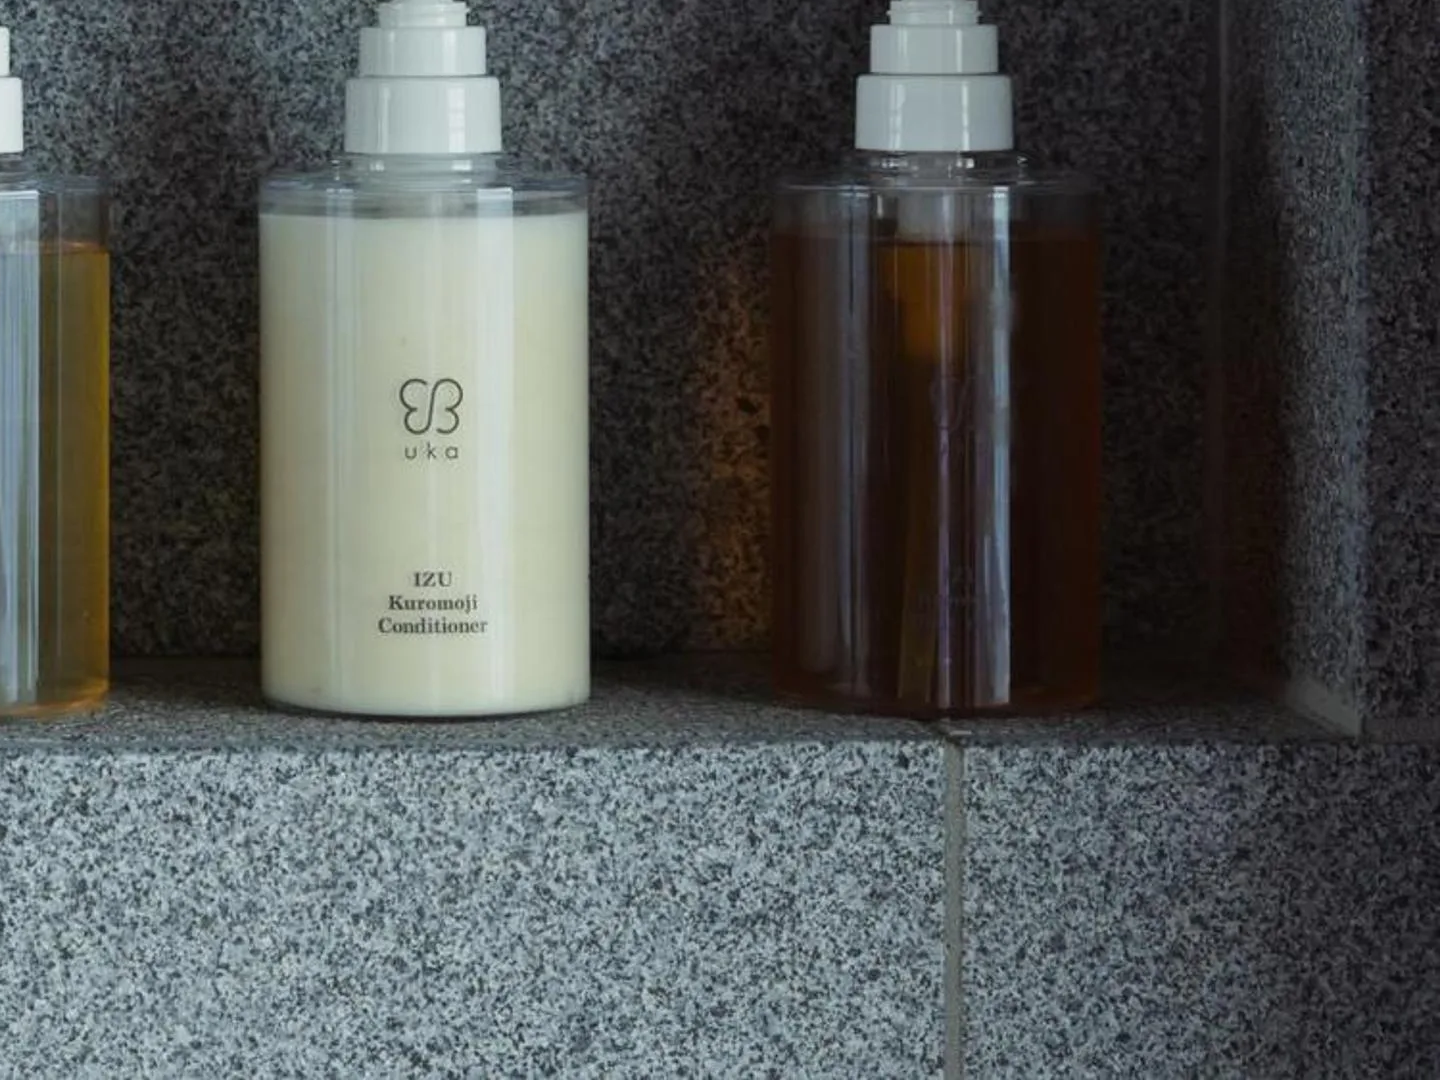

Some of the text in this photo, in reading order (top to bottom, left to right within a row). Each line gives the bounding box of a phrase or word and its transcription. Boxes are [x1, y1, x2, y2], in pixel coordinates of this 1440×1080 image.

[404, 442, 460, 461] uka
[413, 571, 453, 588] IZU
[388, 594, 478, 614] Kuromoji
[378, 616, 489, 635] Conditioner
